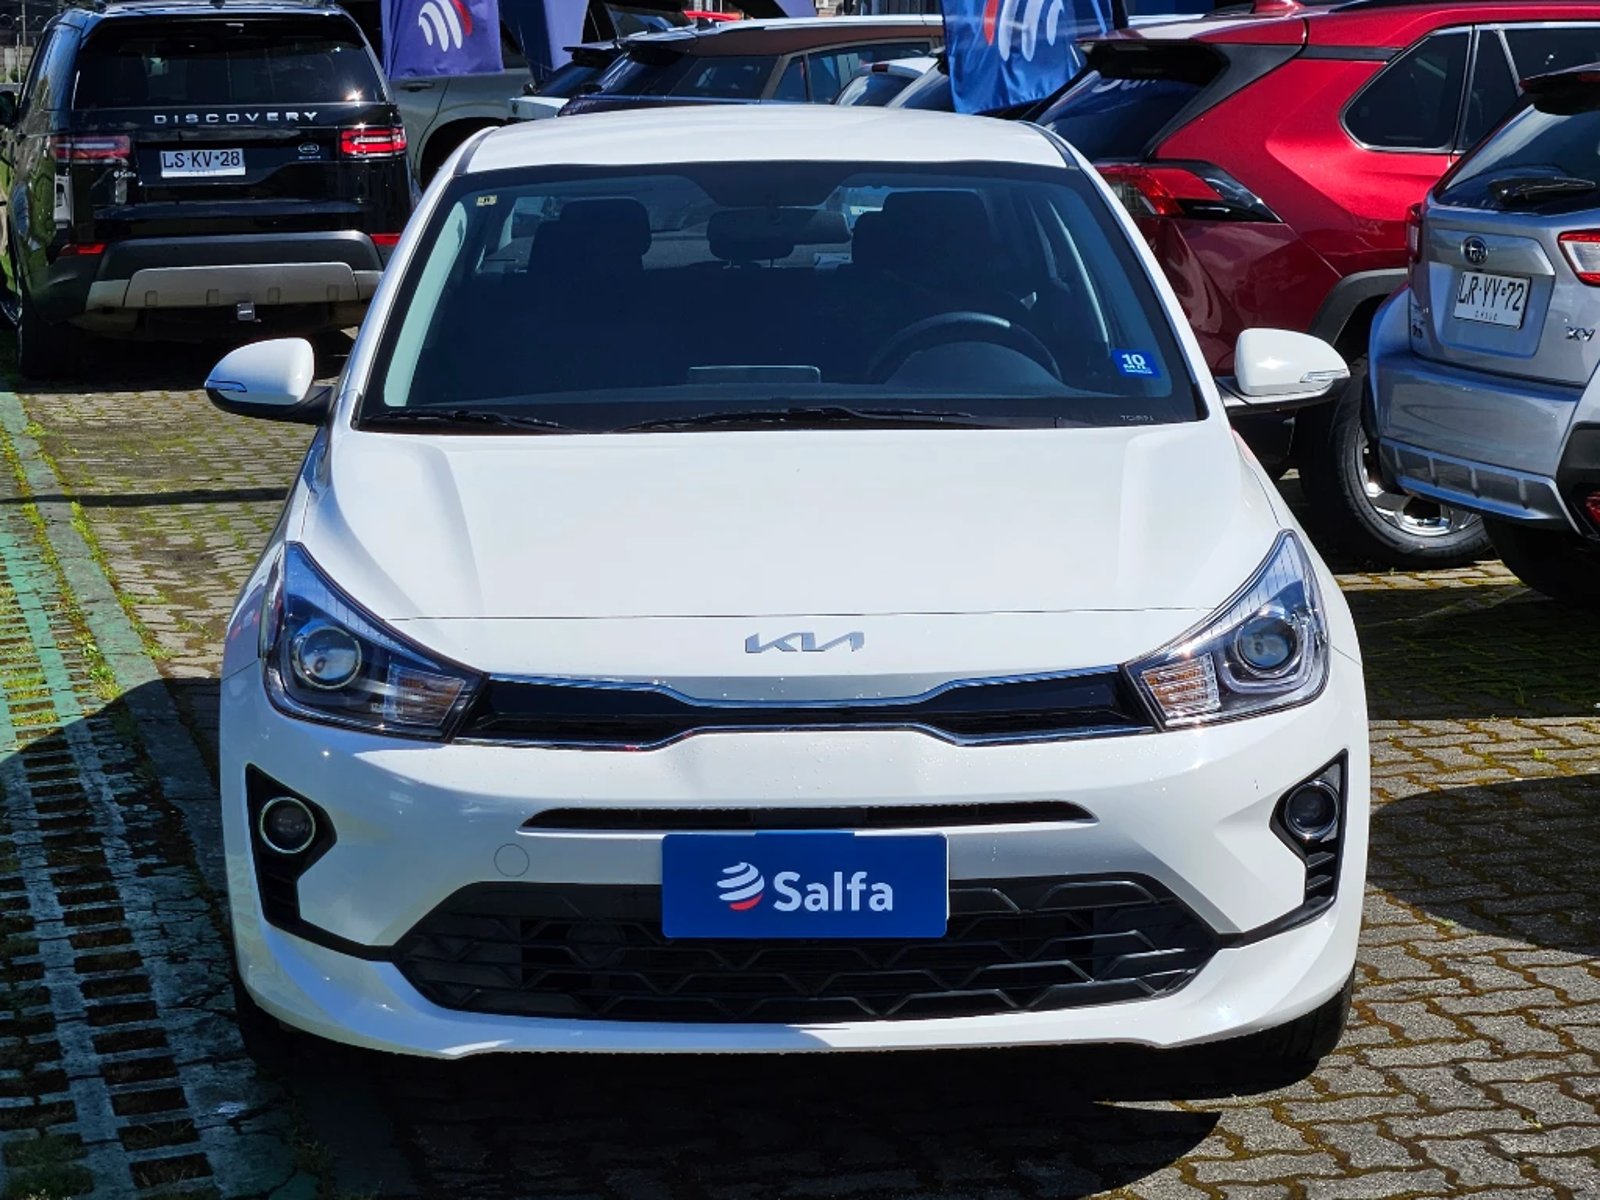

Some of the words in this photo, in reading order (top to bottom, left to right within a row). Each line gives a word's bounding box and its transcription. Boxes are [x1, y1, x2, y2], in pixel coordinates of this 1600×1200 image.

[153, 111, 318, 125] DISCOVERY
[1565, 326, 1596, 342] XV
[1121, 353, 1146, 365] 10
[745, 631, 865, 653] KIA
[773, 871, 894, 912] Salfa
